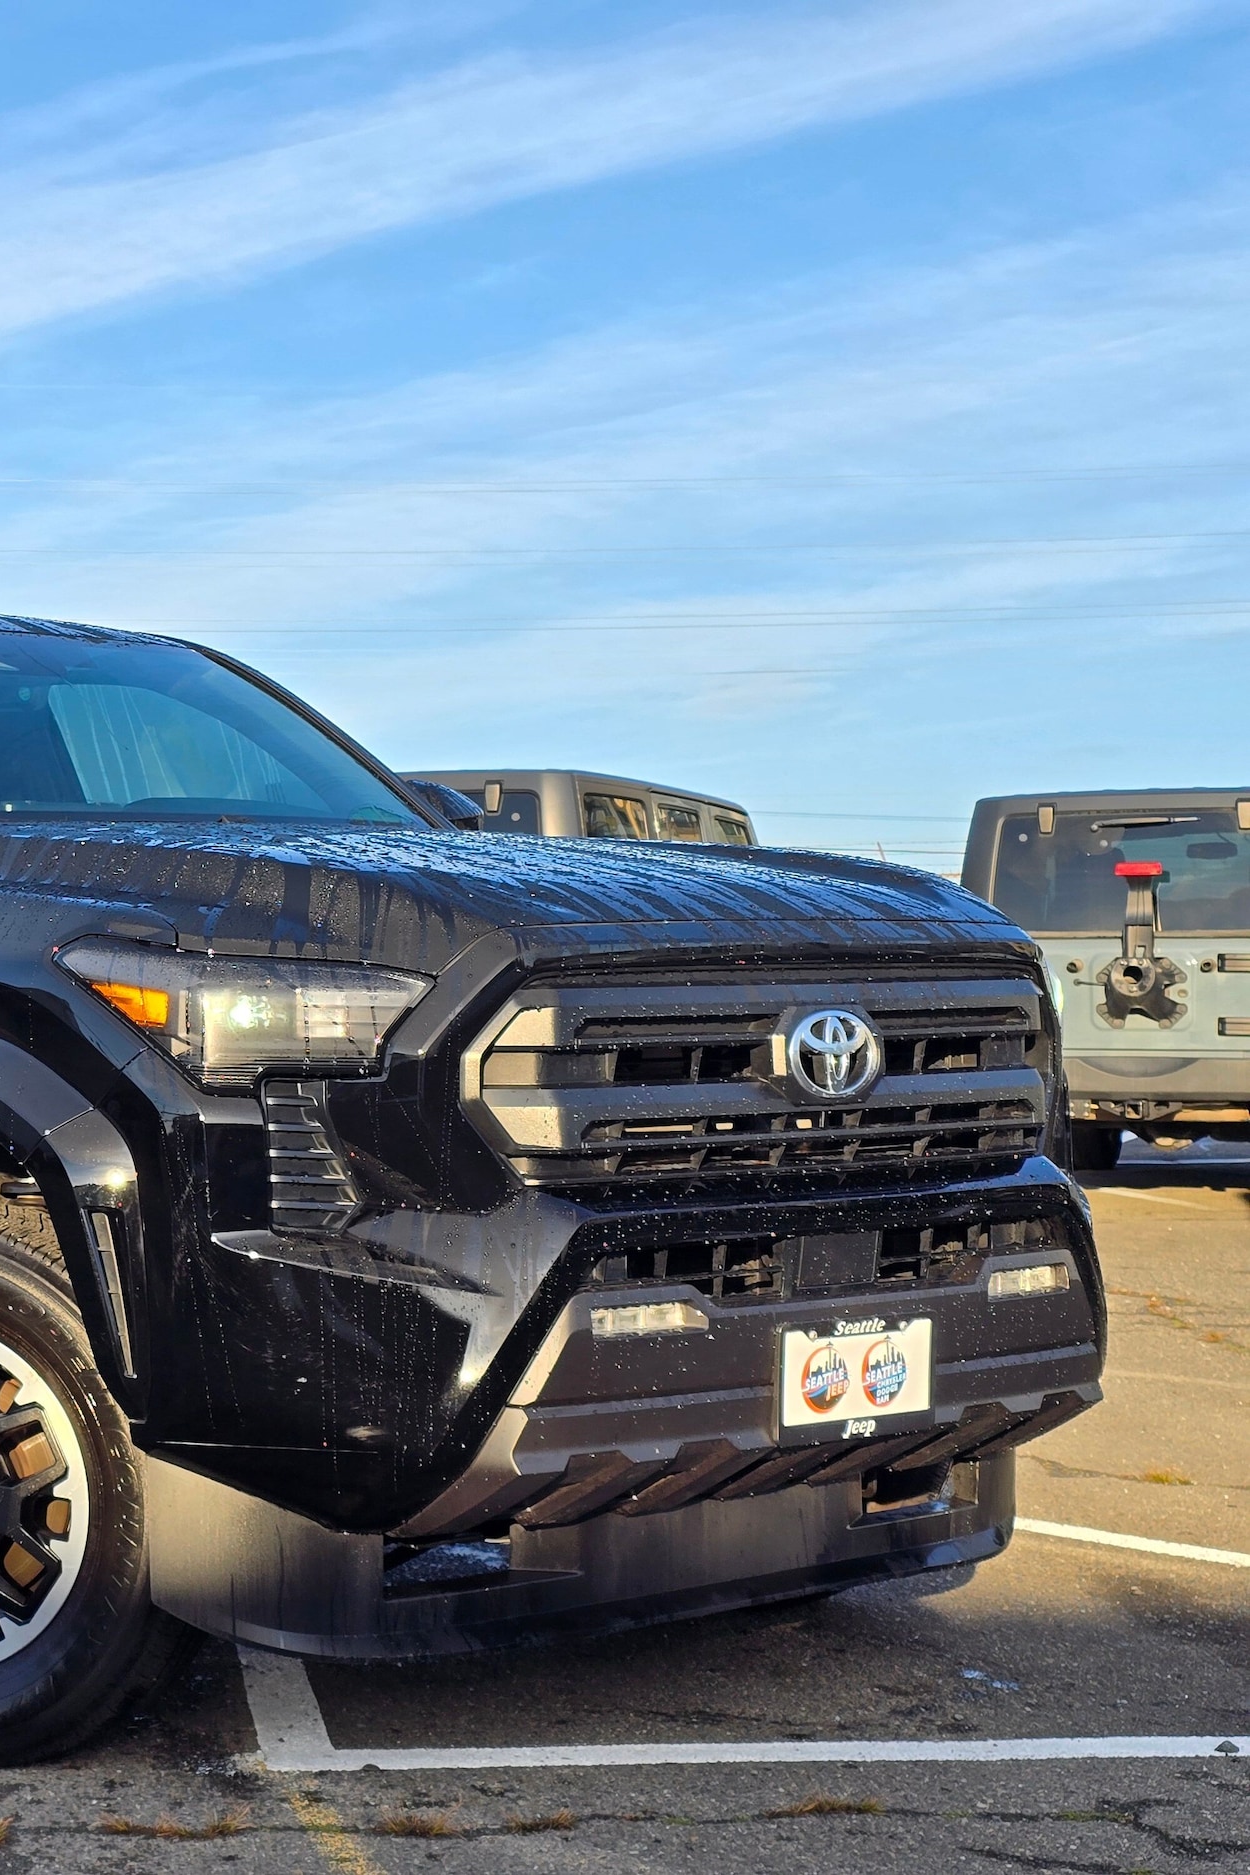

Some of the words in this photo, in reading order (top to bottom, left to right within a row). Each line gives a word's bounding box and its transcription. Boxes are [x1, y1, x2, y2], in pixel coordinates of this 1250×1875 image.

[834, 1318, 886, 1335] Seattle
[805, 1368, 845, 1391] SEATTLE
[865, 1361, 903, 1384] SEATTLE
[825, 1379, 850, 1402] JEEP
[842, 1419, 876, 1439] Jeep
